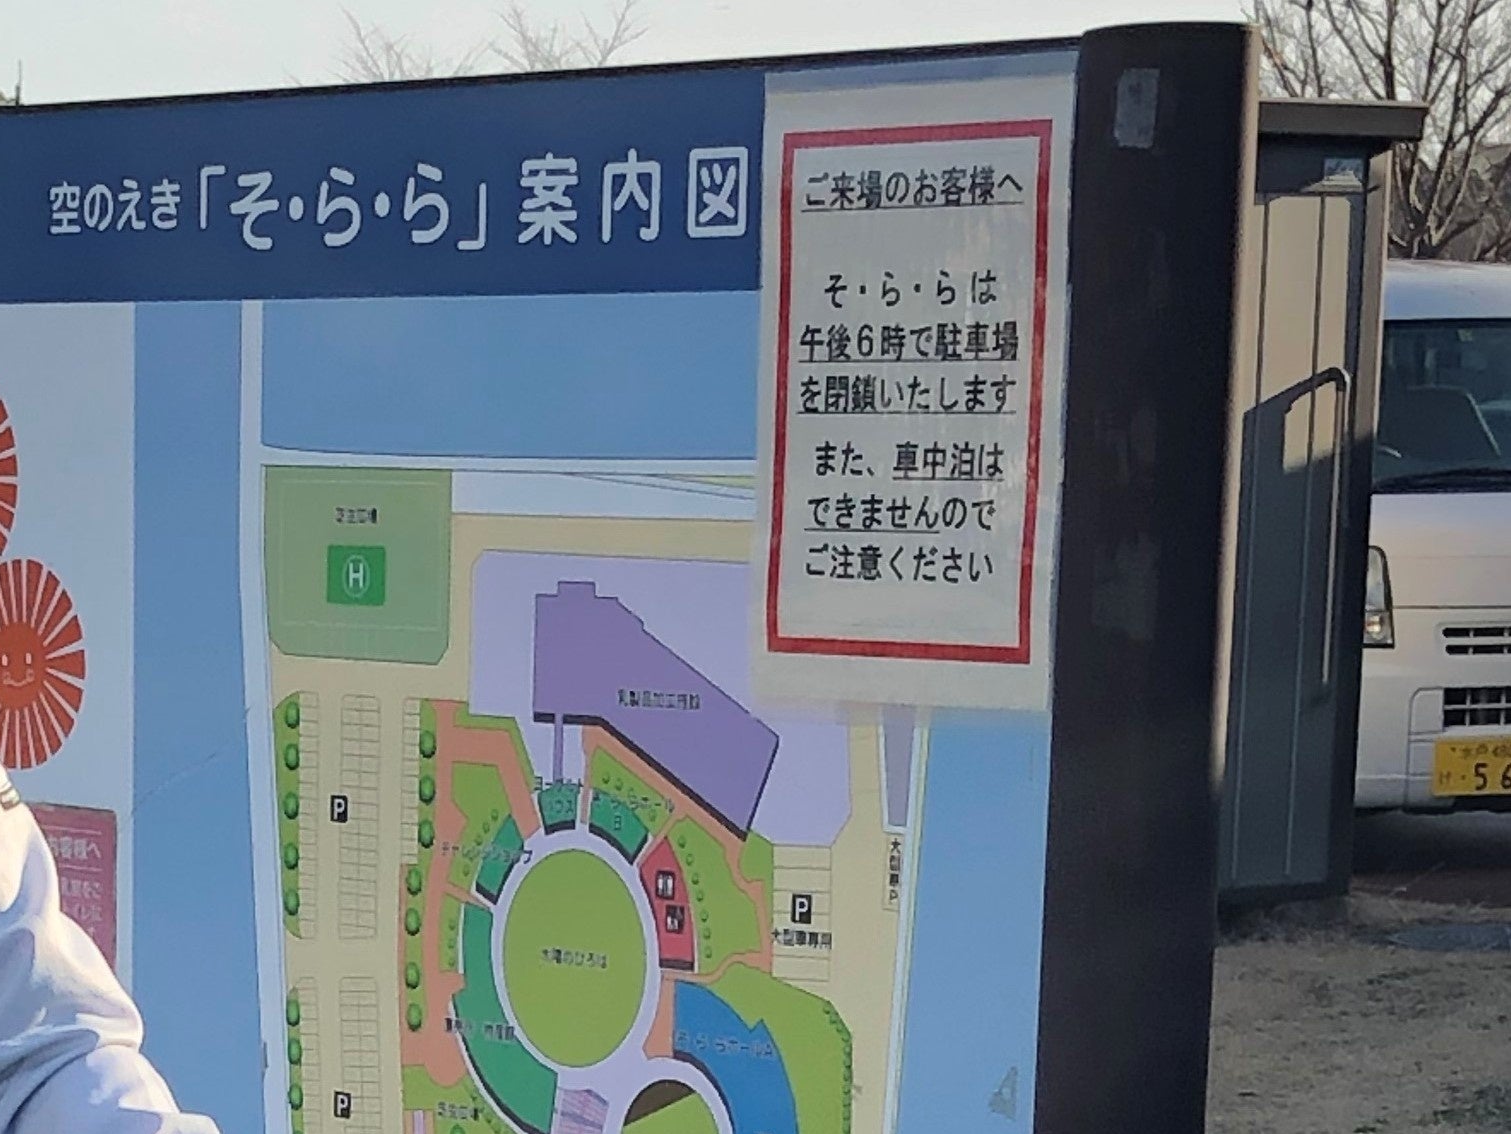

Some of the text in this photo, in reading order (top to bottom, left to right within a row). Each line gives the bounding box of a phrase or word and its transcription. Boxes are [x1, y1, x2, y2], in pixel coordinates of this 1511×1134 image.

[805, 164, 1024, 210] ご来場のお客様へ
[799, 373, 1017, 413] を閉鎖いたします
[814, 440, 1005, 479] また、車中泊は
[806, 492, 997, 531] できませんので
[805, 543, 993, 584] ご注意ください
[795, 897, 809, 922] P
[337, 1094, 348, 1116] P
